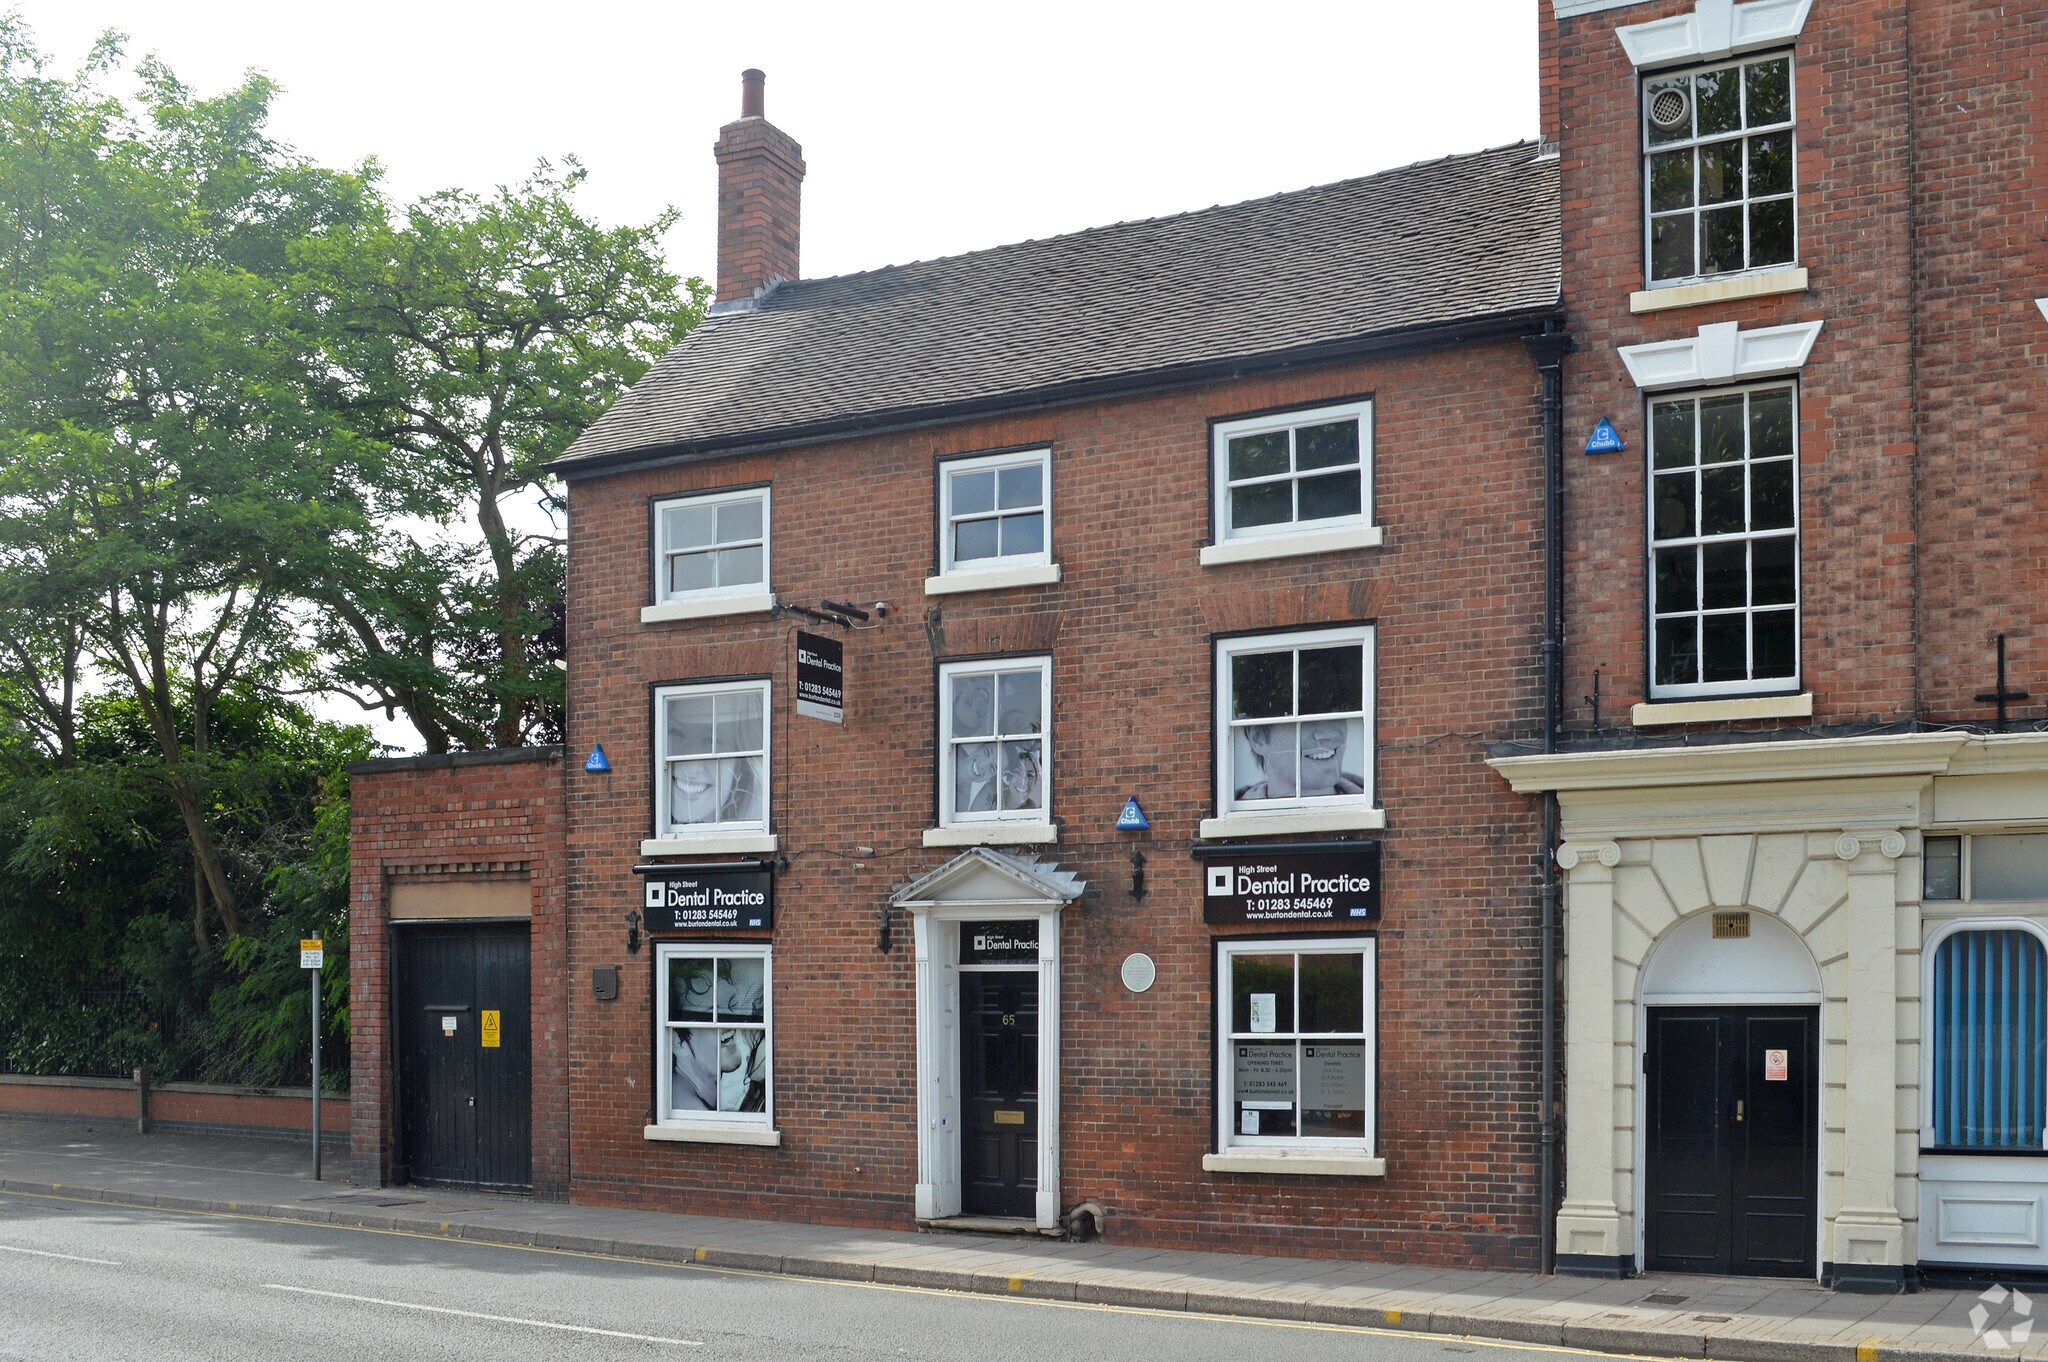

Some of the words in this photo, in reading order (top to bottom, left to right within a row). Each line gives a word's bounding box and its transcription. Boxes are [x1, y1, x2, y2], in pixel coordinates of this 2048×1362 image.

[1591, 439, 1615, 448] Chubb
[807, 655, 823, 668] Dental
[823, 659, 842, 673] Practice
[799, 681, 804, 690] T:
[804, 683, 821, 695] 01283
[822, 687, 842, 699] 545469
[1239, 865, 1255, 875] High
[1256, 865, 1277, 873] Street
[669, 881, 681, 889] High
[1238, 873, 1294, 895] Dental
[1301, 873, 1371, 893] Practice
[668, 888, 709, 907] Dental
[714, 889, 765, 906] Practice
[1246, 899, 1255, 910] T:
[1257, 899, 1291, 910] 01283
[1293, 898, 1333, 909] 545469
[674, 910, 681, 920] T:
[682, 909, 707, 920] 01283
[708, 909, 738, 920] 545469
[1246, 910, 1333, 920] www.burtondental.co.uk
[1350, 908, 1366, 916] NHS
[674, 920, 738, 928] www.burtondental.co.uk
[987, 939, 1012, 950] Dental
[1014, 939, 1039, 950] Practic
[1002, 1014, 1015, 1026] 65
[1249, 1050, 1268, 1058] Dental
[1270, 1050, 1292, 1058] Practice
[1316, 1050, 1335, 1058] Dental
[1337, 1050, 1361, 1058] Practice
